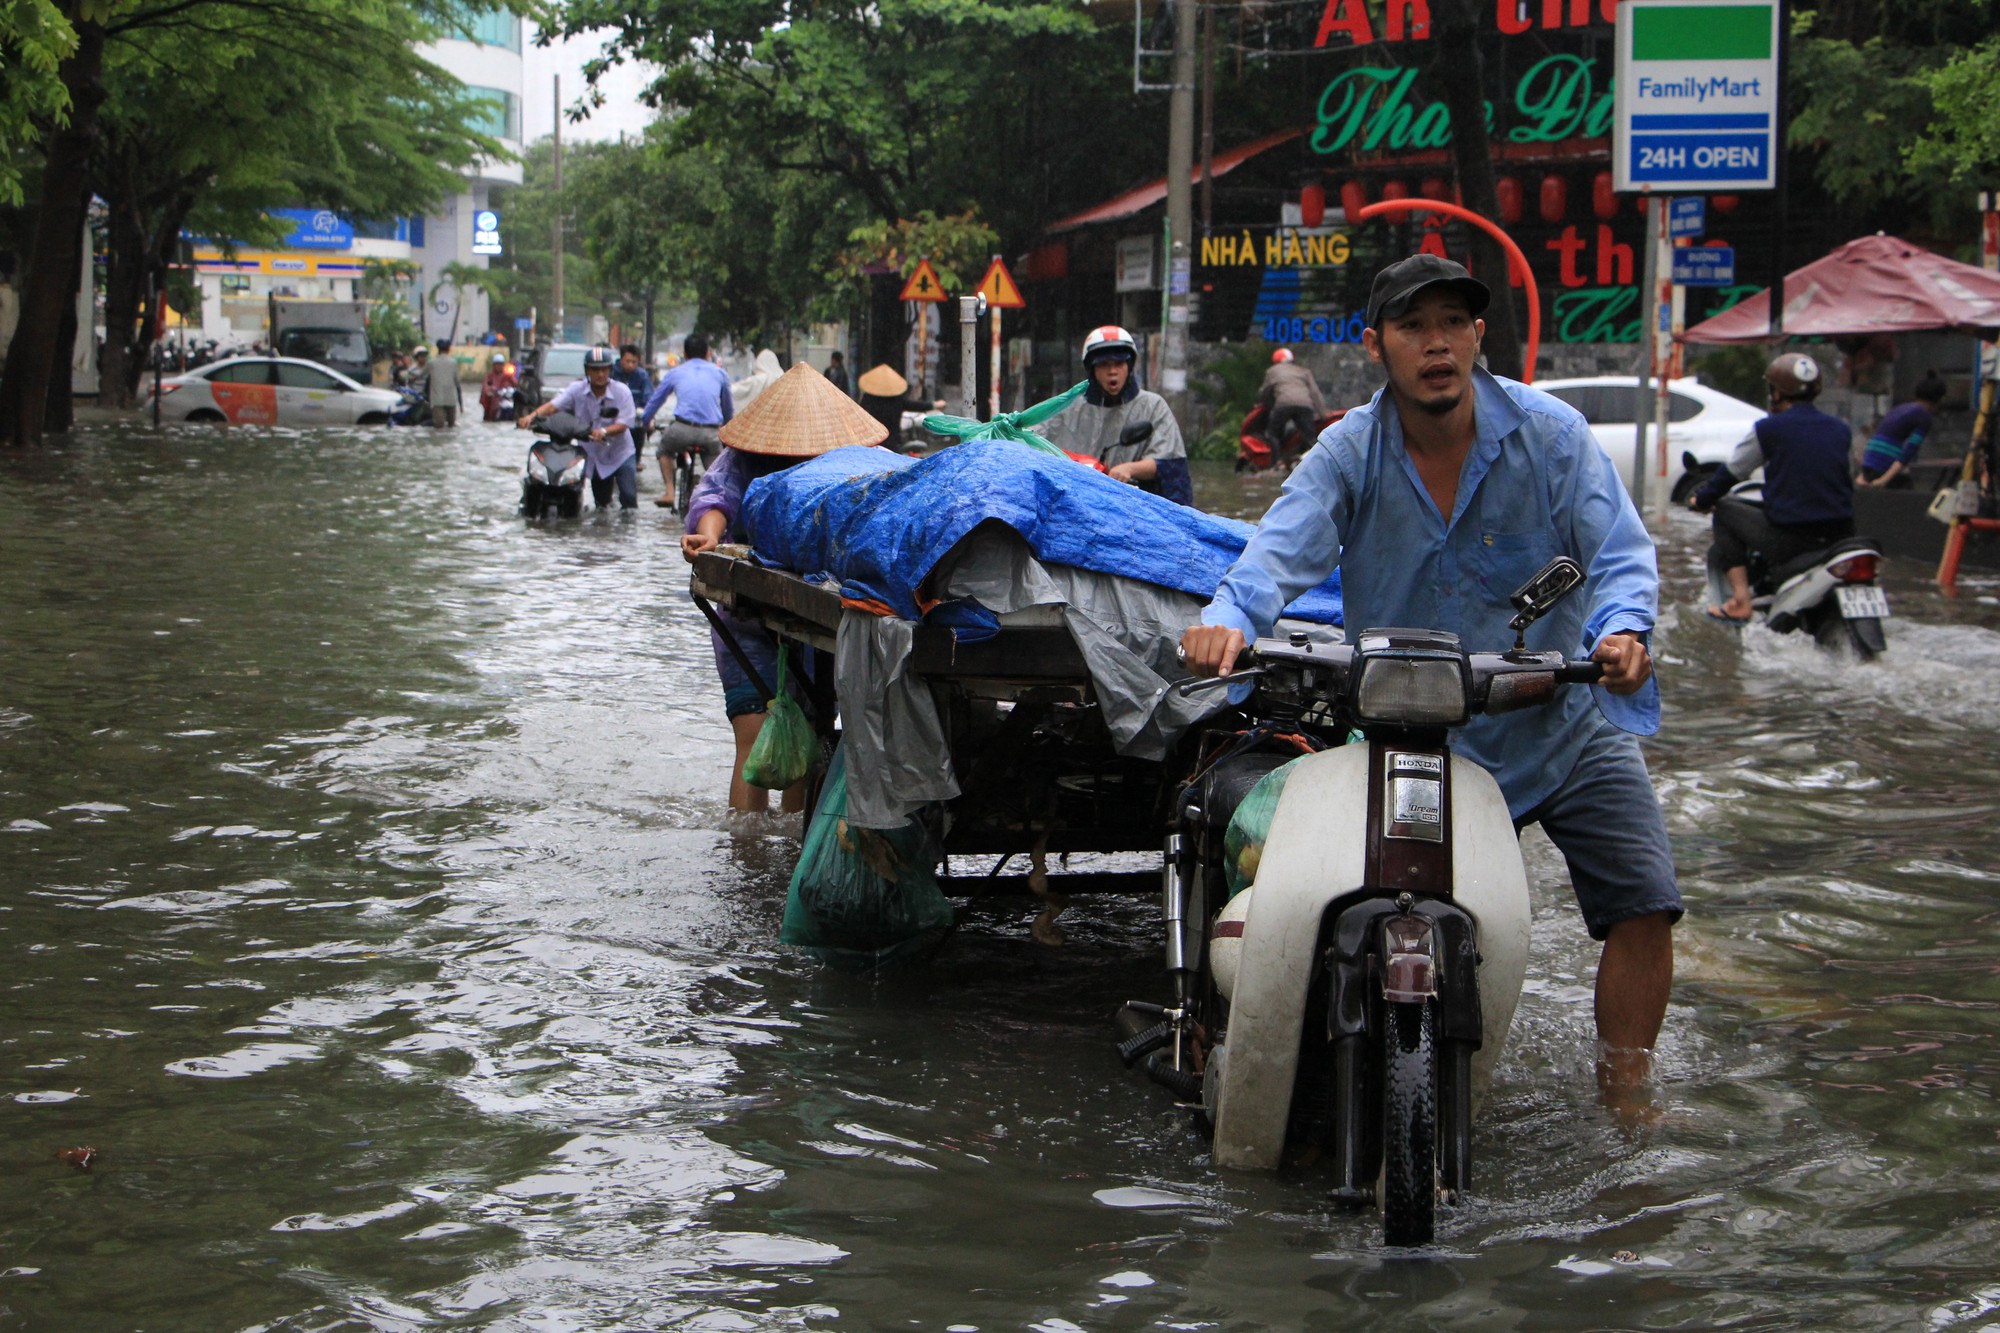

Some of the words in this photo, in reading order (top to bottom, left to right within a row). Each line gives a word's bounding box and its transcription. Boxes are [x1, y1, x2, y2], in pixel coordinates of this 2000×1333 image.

[1639, 76, 1761, 103] FamilyMart
[1639, 147, 1686, 169] 24H
[1693, 146, 1760, 169] OPEN
[1201, 229, 1258, 266] NHÀ
[1265, 228, 1351, 265] HÀNG
[1546, 224, 1634, 287] th
[1309, 308, 1367, 343] QUỐ
[1398, 760, 1439, 769] HONDA
[1410, 804, 1438, 814] Dream
